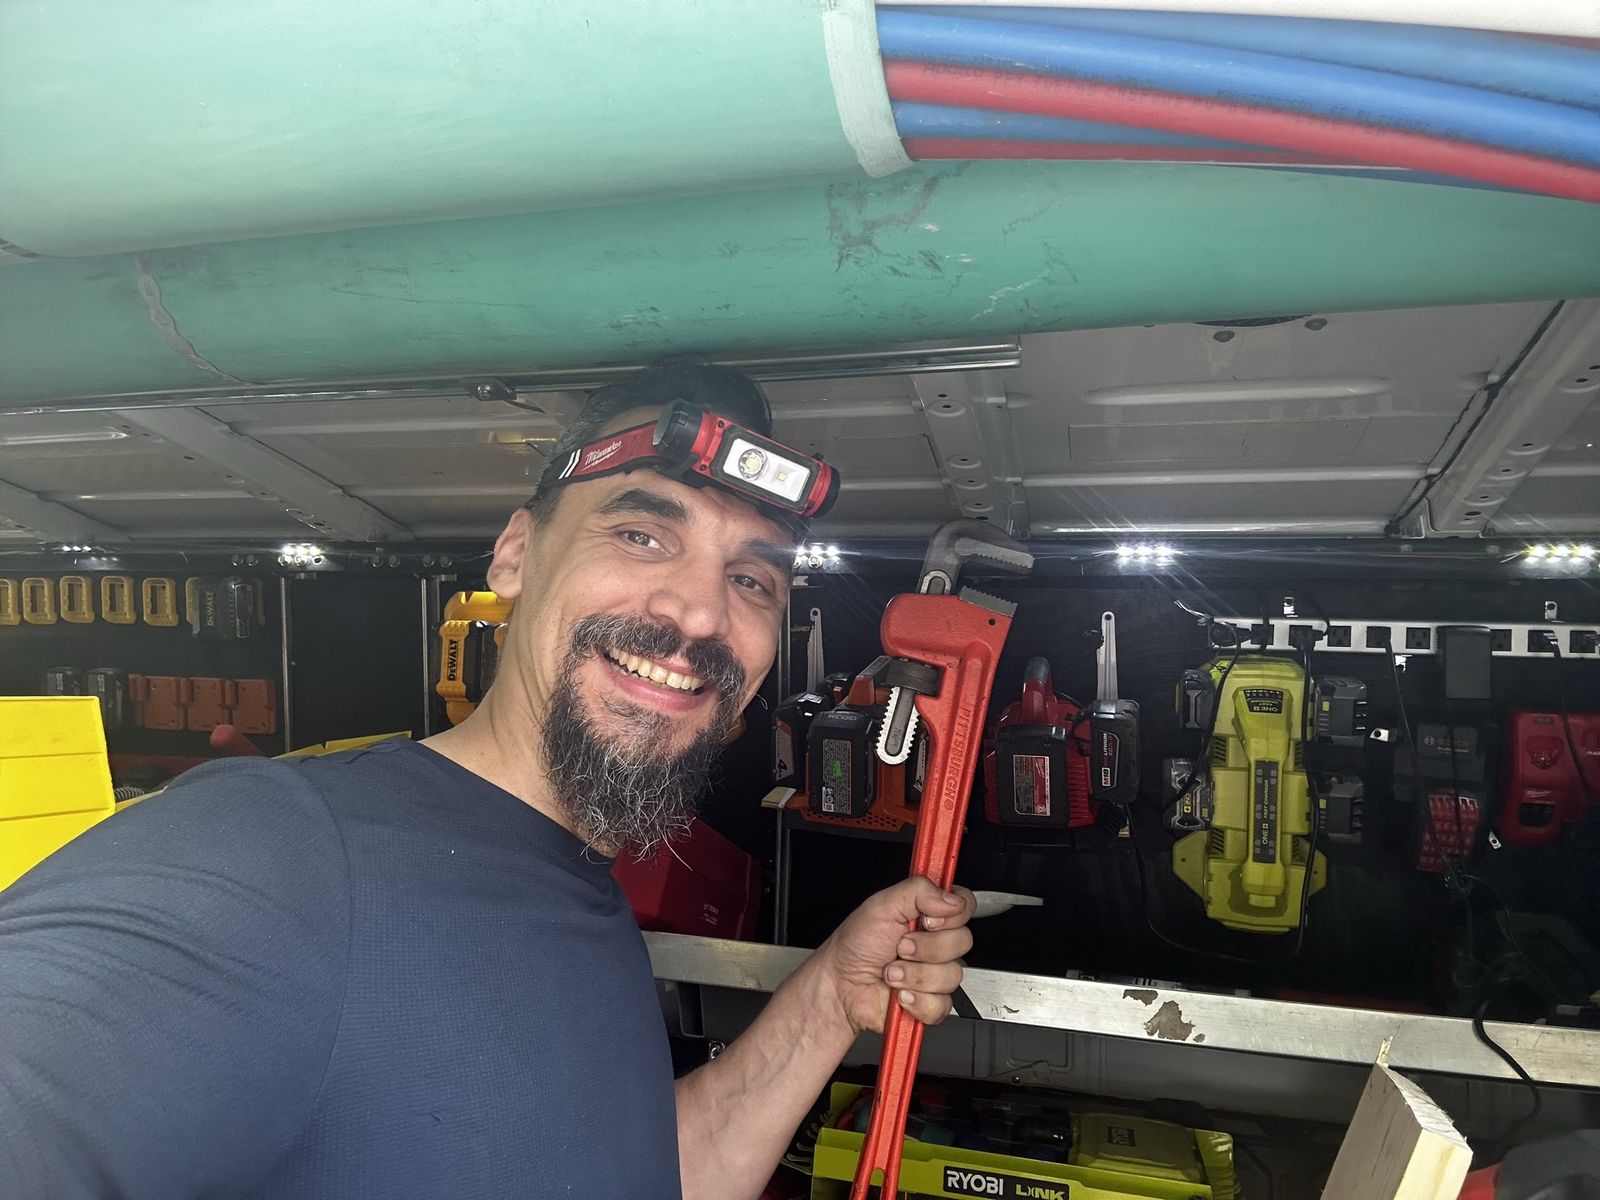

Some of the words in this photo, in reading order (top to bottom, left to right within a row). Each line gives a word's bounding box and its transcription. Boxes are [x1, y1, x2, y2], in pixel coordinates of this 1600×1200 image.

[584, 440, 623, 467] Milwaukee
[446, 639, 458, 682] DEWALT
[946, 1170, 1004, 1196] RYOBI
